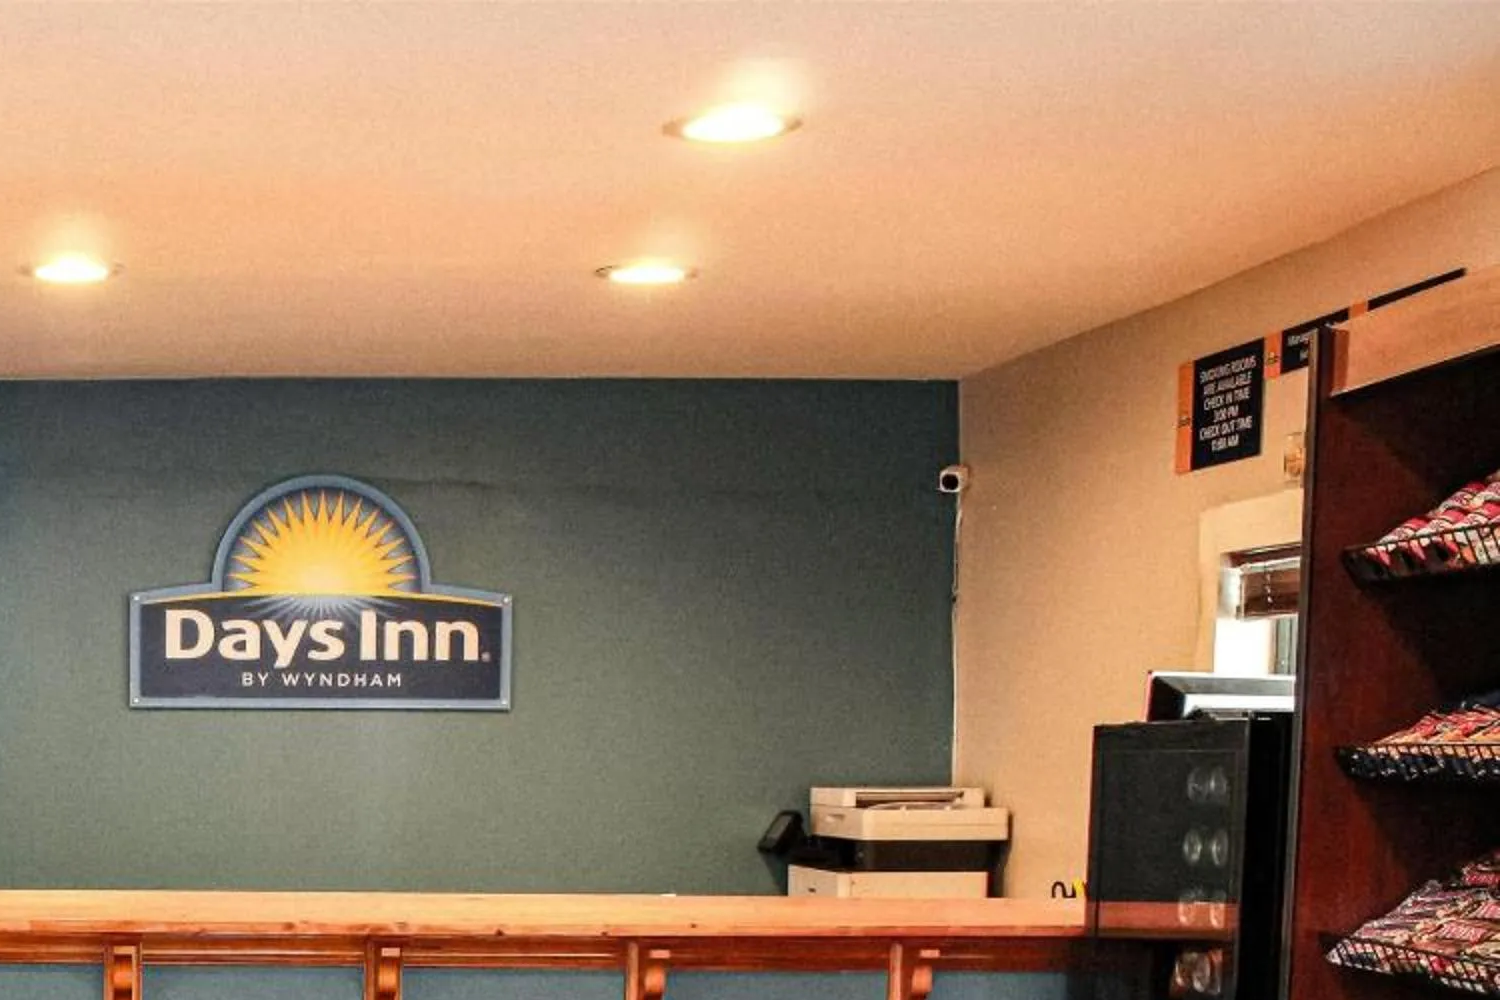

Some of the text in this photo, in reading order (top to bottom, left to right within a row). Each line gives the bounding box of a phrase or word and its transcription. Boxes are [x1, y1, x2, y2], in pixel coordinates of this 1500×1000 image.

[165, 609, 480, 669] Days Inn
[241, 672, 402, 688] BY WYNDHAM
